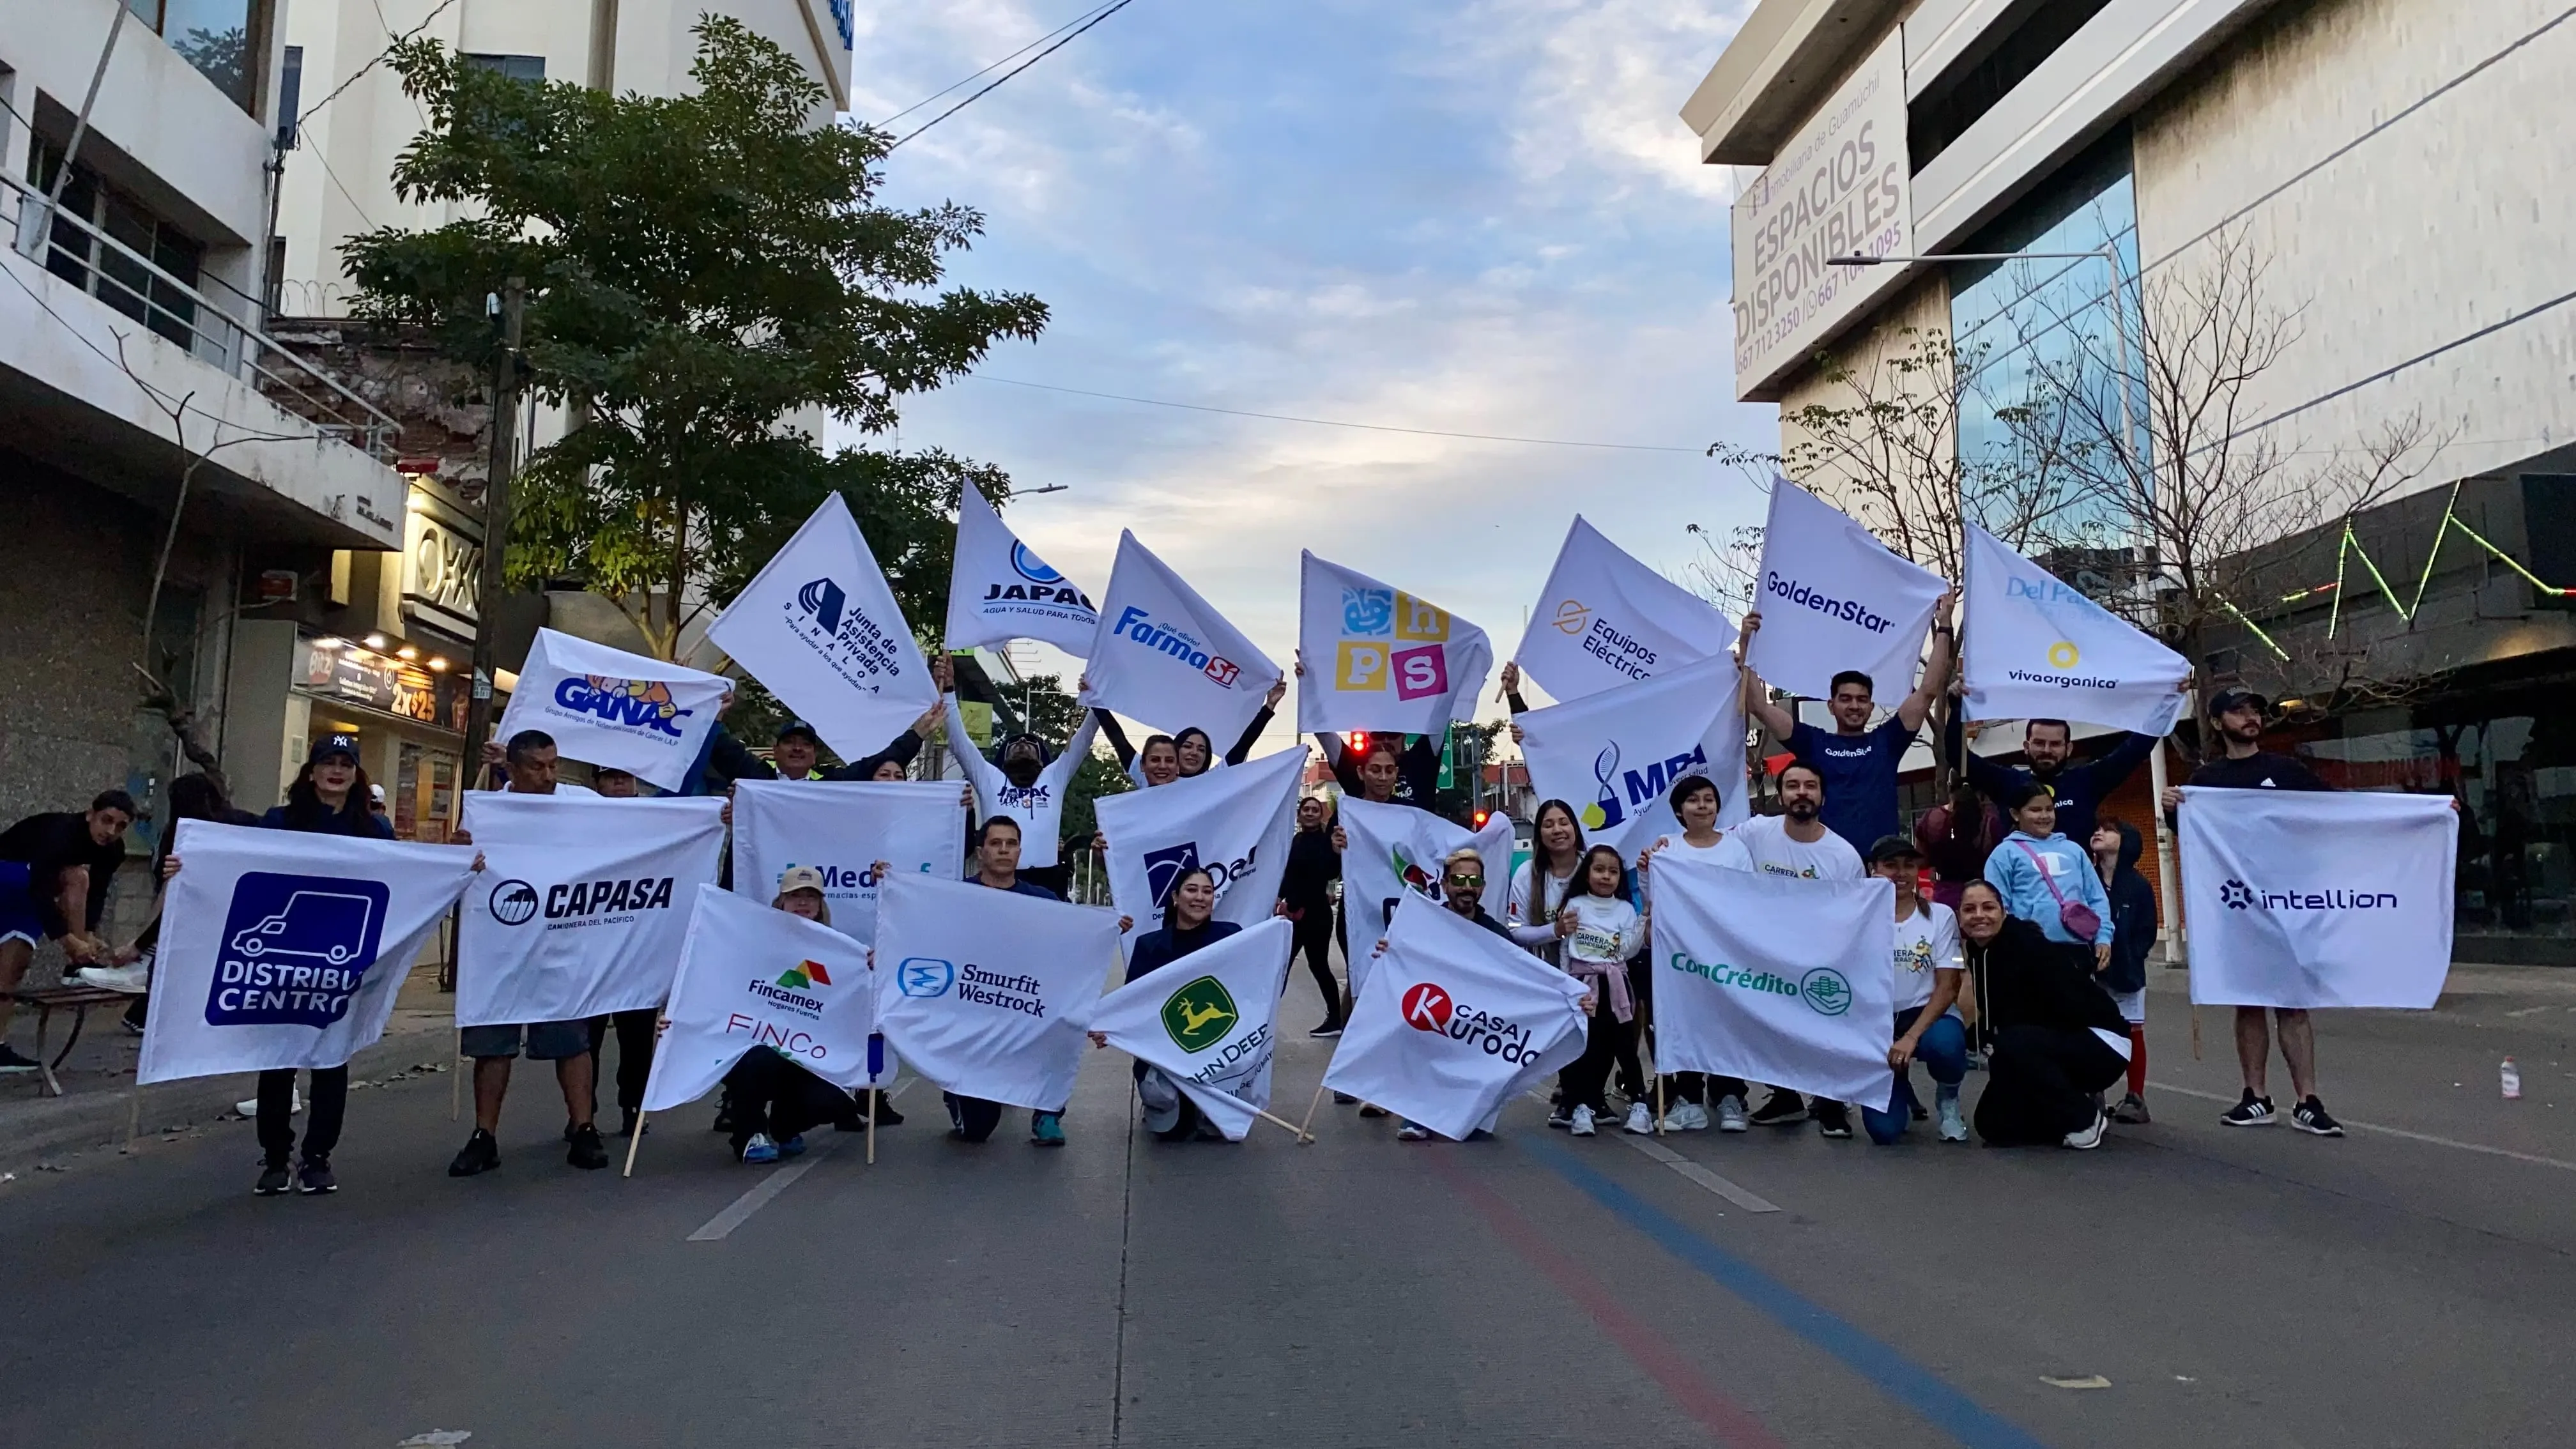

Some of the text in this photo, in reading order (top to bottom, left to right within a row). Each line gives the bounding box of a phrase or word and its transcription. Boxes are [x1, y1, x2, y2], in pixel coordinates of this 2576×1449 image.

[1815, 130, 1826, 152] de
[1754, 119, 1875, 277] ESPACIOS
[1736, 162, 1900, 348] DISPONIBLES
[1738, 344, 1753, 375] 667
[1755, 328, 1772, 360] 712
[1774, 306, 1800, 344] 3250
[1818, 272, 1839, 307] 667
[1868, 220, 1901, 259] 1095
[1768, 571, 1891, 634] GoldenStar
[2006, 577, 2045, 601] Del
[848, 607, 898, 655] Junta de
[1016, 607, 1045, 616] SALUD
[1046, 610, 1069, 620] PARA
[1071, 614, 1096, 625] TODOS
[799, 632, 820, 651] ayudar
[822, 652, 832, 663] los
[831, 661, 843, 673] que
[836, 631, 880, 675] Privada
[840, 618, 900, 677] Asistencia
[1592, 618, 1657, 665] Equipos
[2009, 670, 2117, 689] vivaorganica
[545, 705, 563, 717] Grupo
[563, 712, 586, 723] Amigos
[544, 877, 674, 919] CAPASA
[2261, 889, 2397, 910] intellion
[548, 915, 634, 930] CAMIONERA DEL PACÍFICO
[961, 963, 1041, 995] Smurfit
[1671, 952, 1798, 996] ConCrédito
[748, 979, 825, 1013] Fincamex
[767, 1000, 820, 1021] Hogares Fuertes
[958, 982, 1046, 1018] Westrock
[1455, 1004, 1519, 1041] CASA
